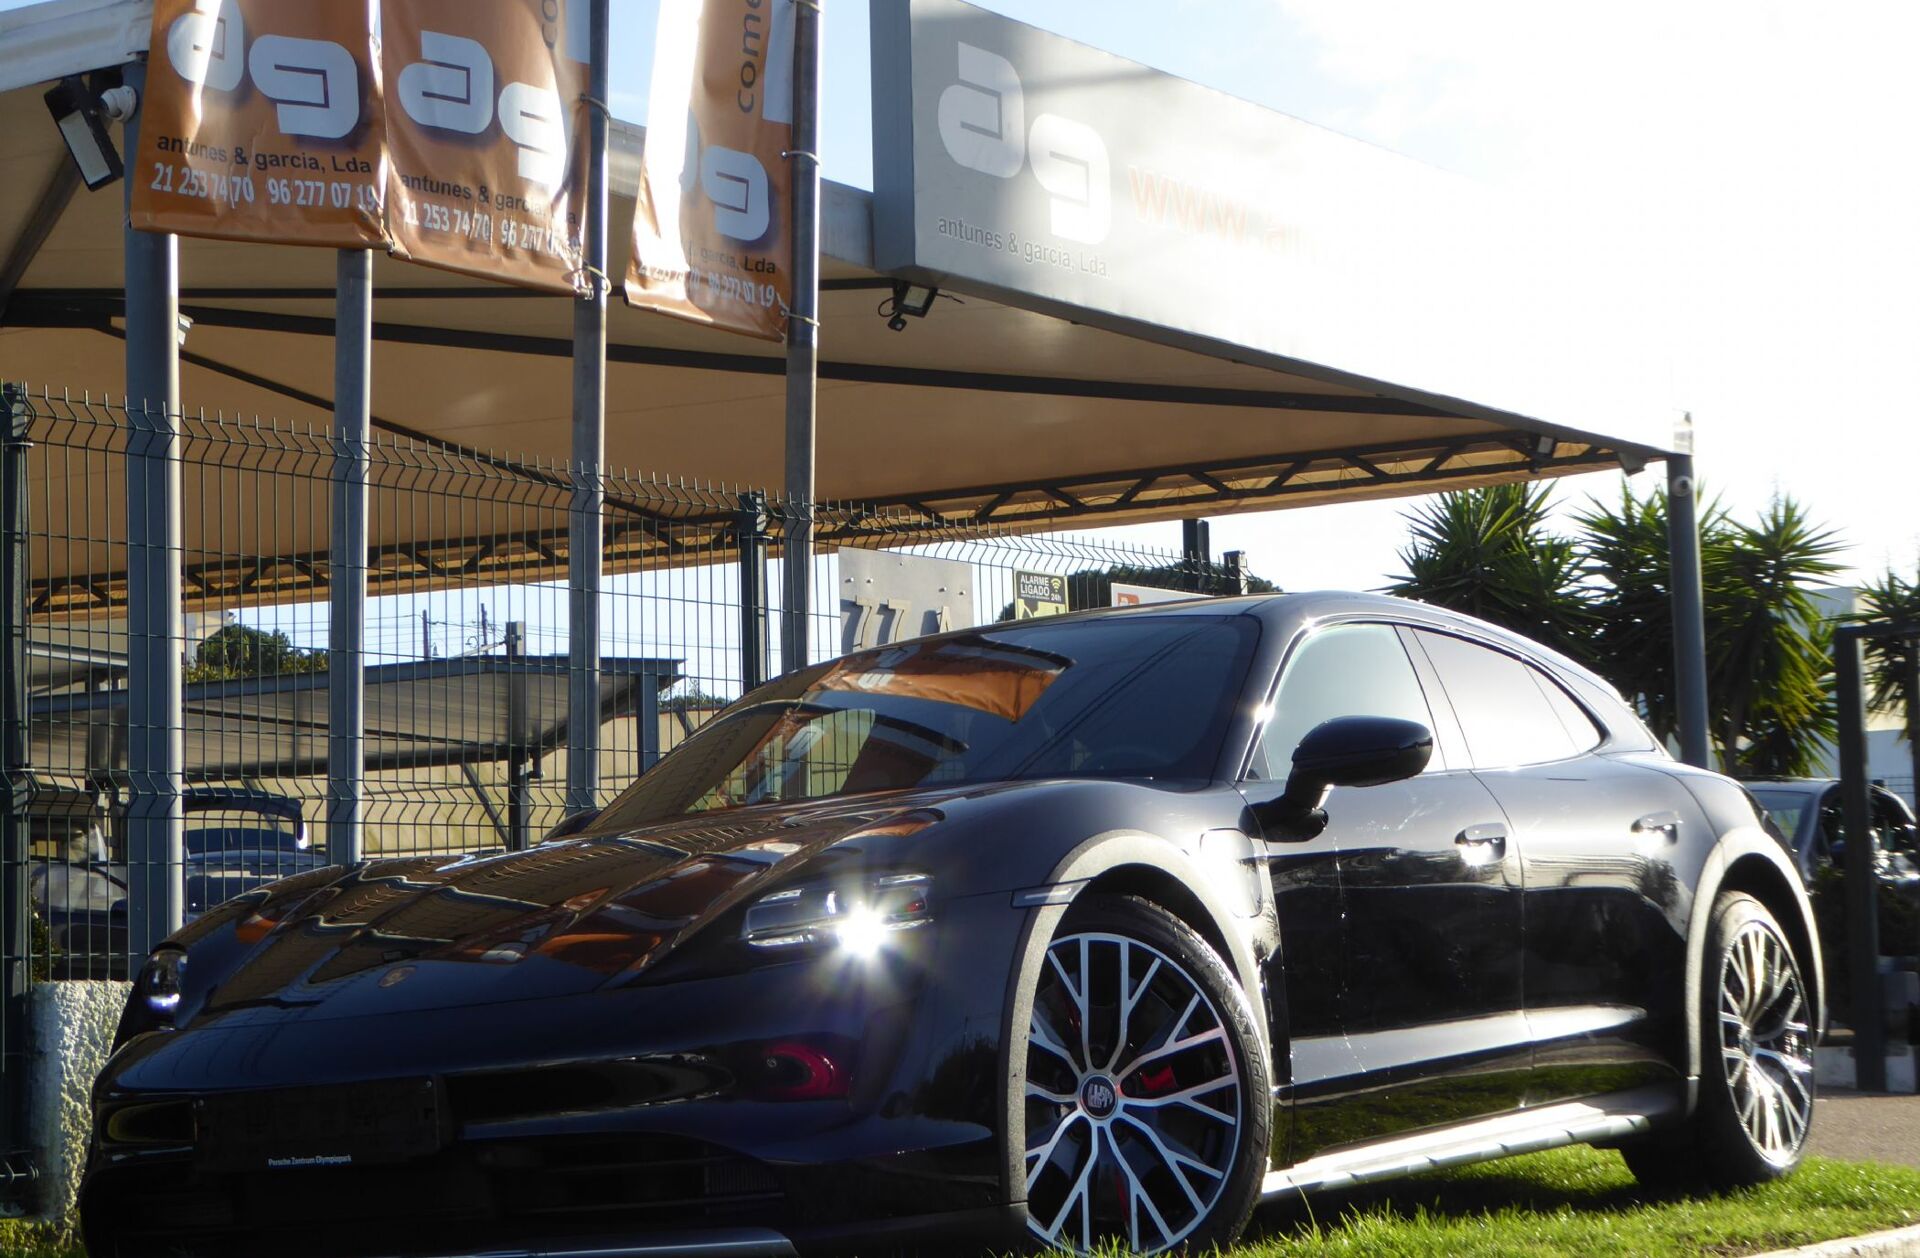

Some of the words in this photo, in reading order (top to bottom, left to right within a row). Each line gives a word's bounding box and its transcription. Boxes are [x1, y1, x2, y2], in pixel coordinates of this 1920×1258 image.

[157, 135, 227, 162] antunes
[234, 147, 249, 165] &
[255, 151, 326, 173] garcia,
[332, 155, 372, 174] Lda
[151, 162, 172, 192] 21
[178, 168, 208, 198] 253
[211, 173, 228, 201] 74
[231, 175, 255, 202] 70
[267, 178, 292, 205] 96
[294, 179, 325, 207] 277
[331, 182, 351, 209] 07
[357, 184, 377, 211] 19
[401, 174, 472, 200] antunes
[478, 185, 490, 203] &
[423, 203, 450, 232] 253
[453, 208, 471, 235] 74
[473, 212, 491, 240] 70
[938, 216, 1003, 250] antunes
[1007, 231, 1019, 254] &
[1024, 241, 1075, 271] garcia,
[1080, 251, 1111, 278] Lda.
[743, 255, 777, 274] Lda
[760, 284, 776, 308] 19
[1021, 574, 1049, 587] ALARME
[1021, 584, 1050, 597] LIGADO
